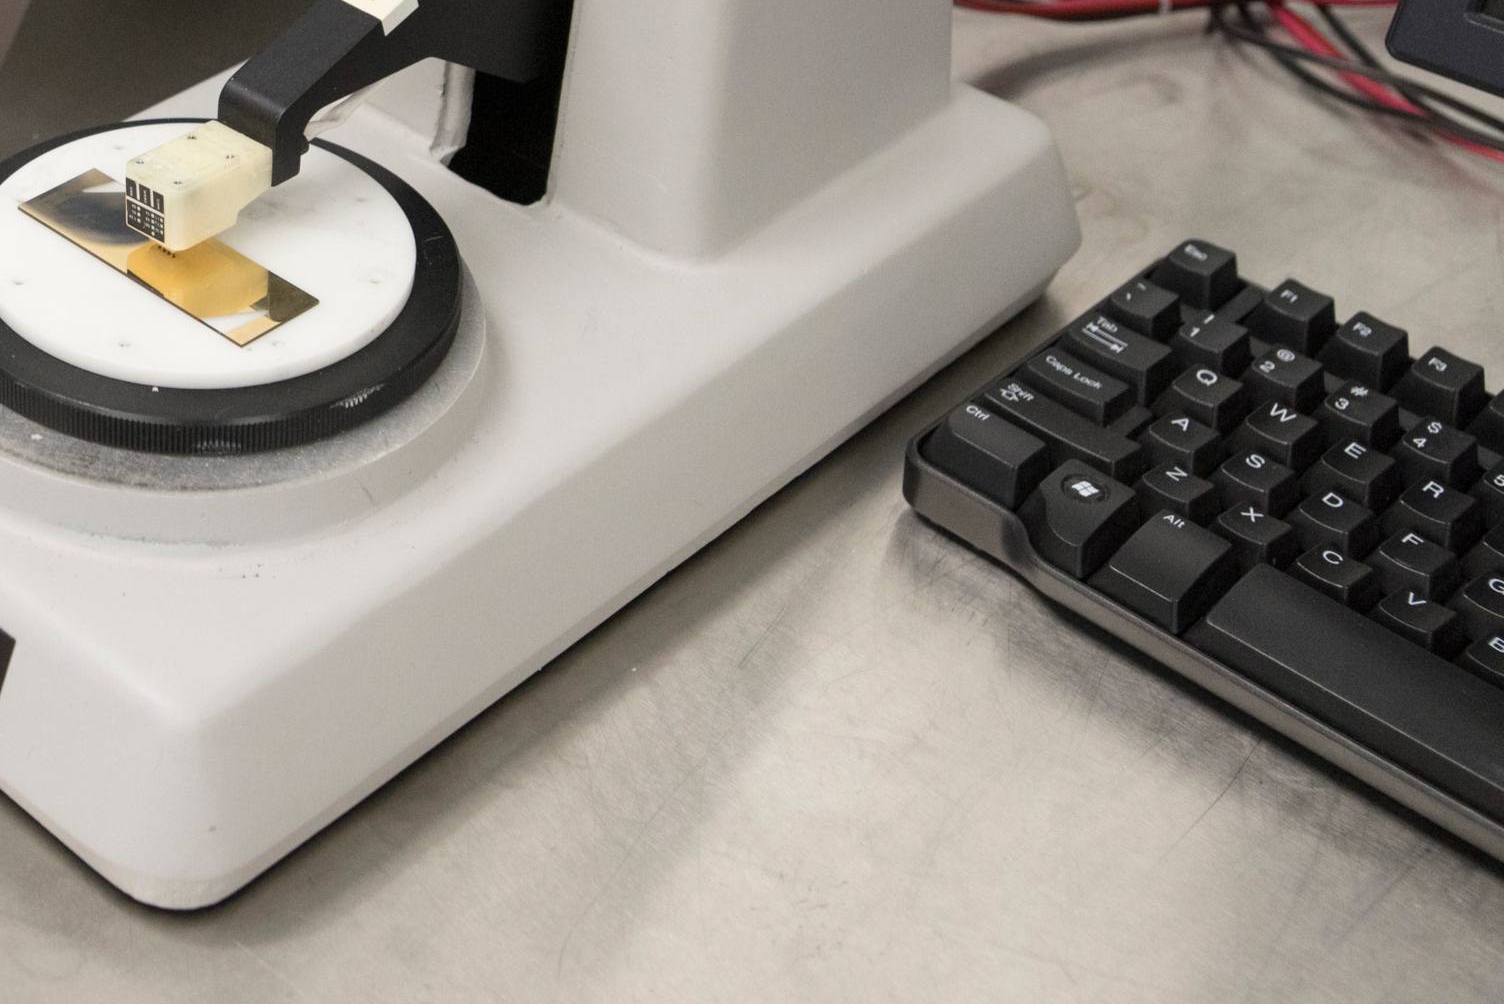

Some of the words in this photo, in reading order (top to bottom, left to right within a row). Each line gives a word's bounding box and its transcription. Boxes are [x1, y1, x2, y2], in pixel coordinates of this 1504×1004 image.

[1280, 289, 1298, 303] F1
[1096, 315, 1119, 333] Tab
[1353, 322, 1372, 337] F2
[1259, 361, 1275, 374] 2
[1428, 357, 1447, 372] F3
[1046, 355, 1073, 376] Caps
[1073, 371, 1103, 390] Lock
[1196, 369, 1218, 387] Q
[1334, 397, 1349, 410] 3
[966, 405, 992, 421] Ctrl
[1270, 403, 1297, 423] W
[1171, 417, 1190, 432] A
[1412, 437, 1427, 448] 4
[1344, 441, 1367, 460] E
[1245, 453, 1265, 468] S
[1165, 466, 1188, 482] Z
[1422, 480, 1445, 498] R
[1321, 492, 1344, 508] D
[1162, 514, 1186, 529] Alt
[1240, 506, 1264, 523] X
[1401, 532, 1424, 546] F
[1322, 550, 1343, 565] C
[1407, 591, 1427, 606] V
